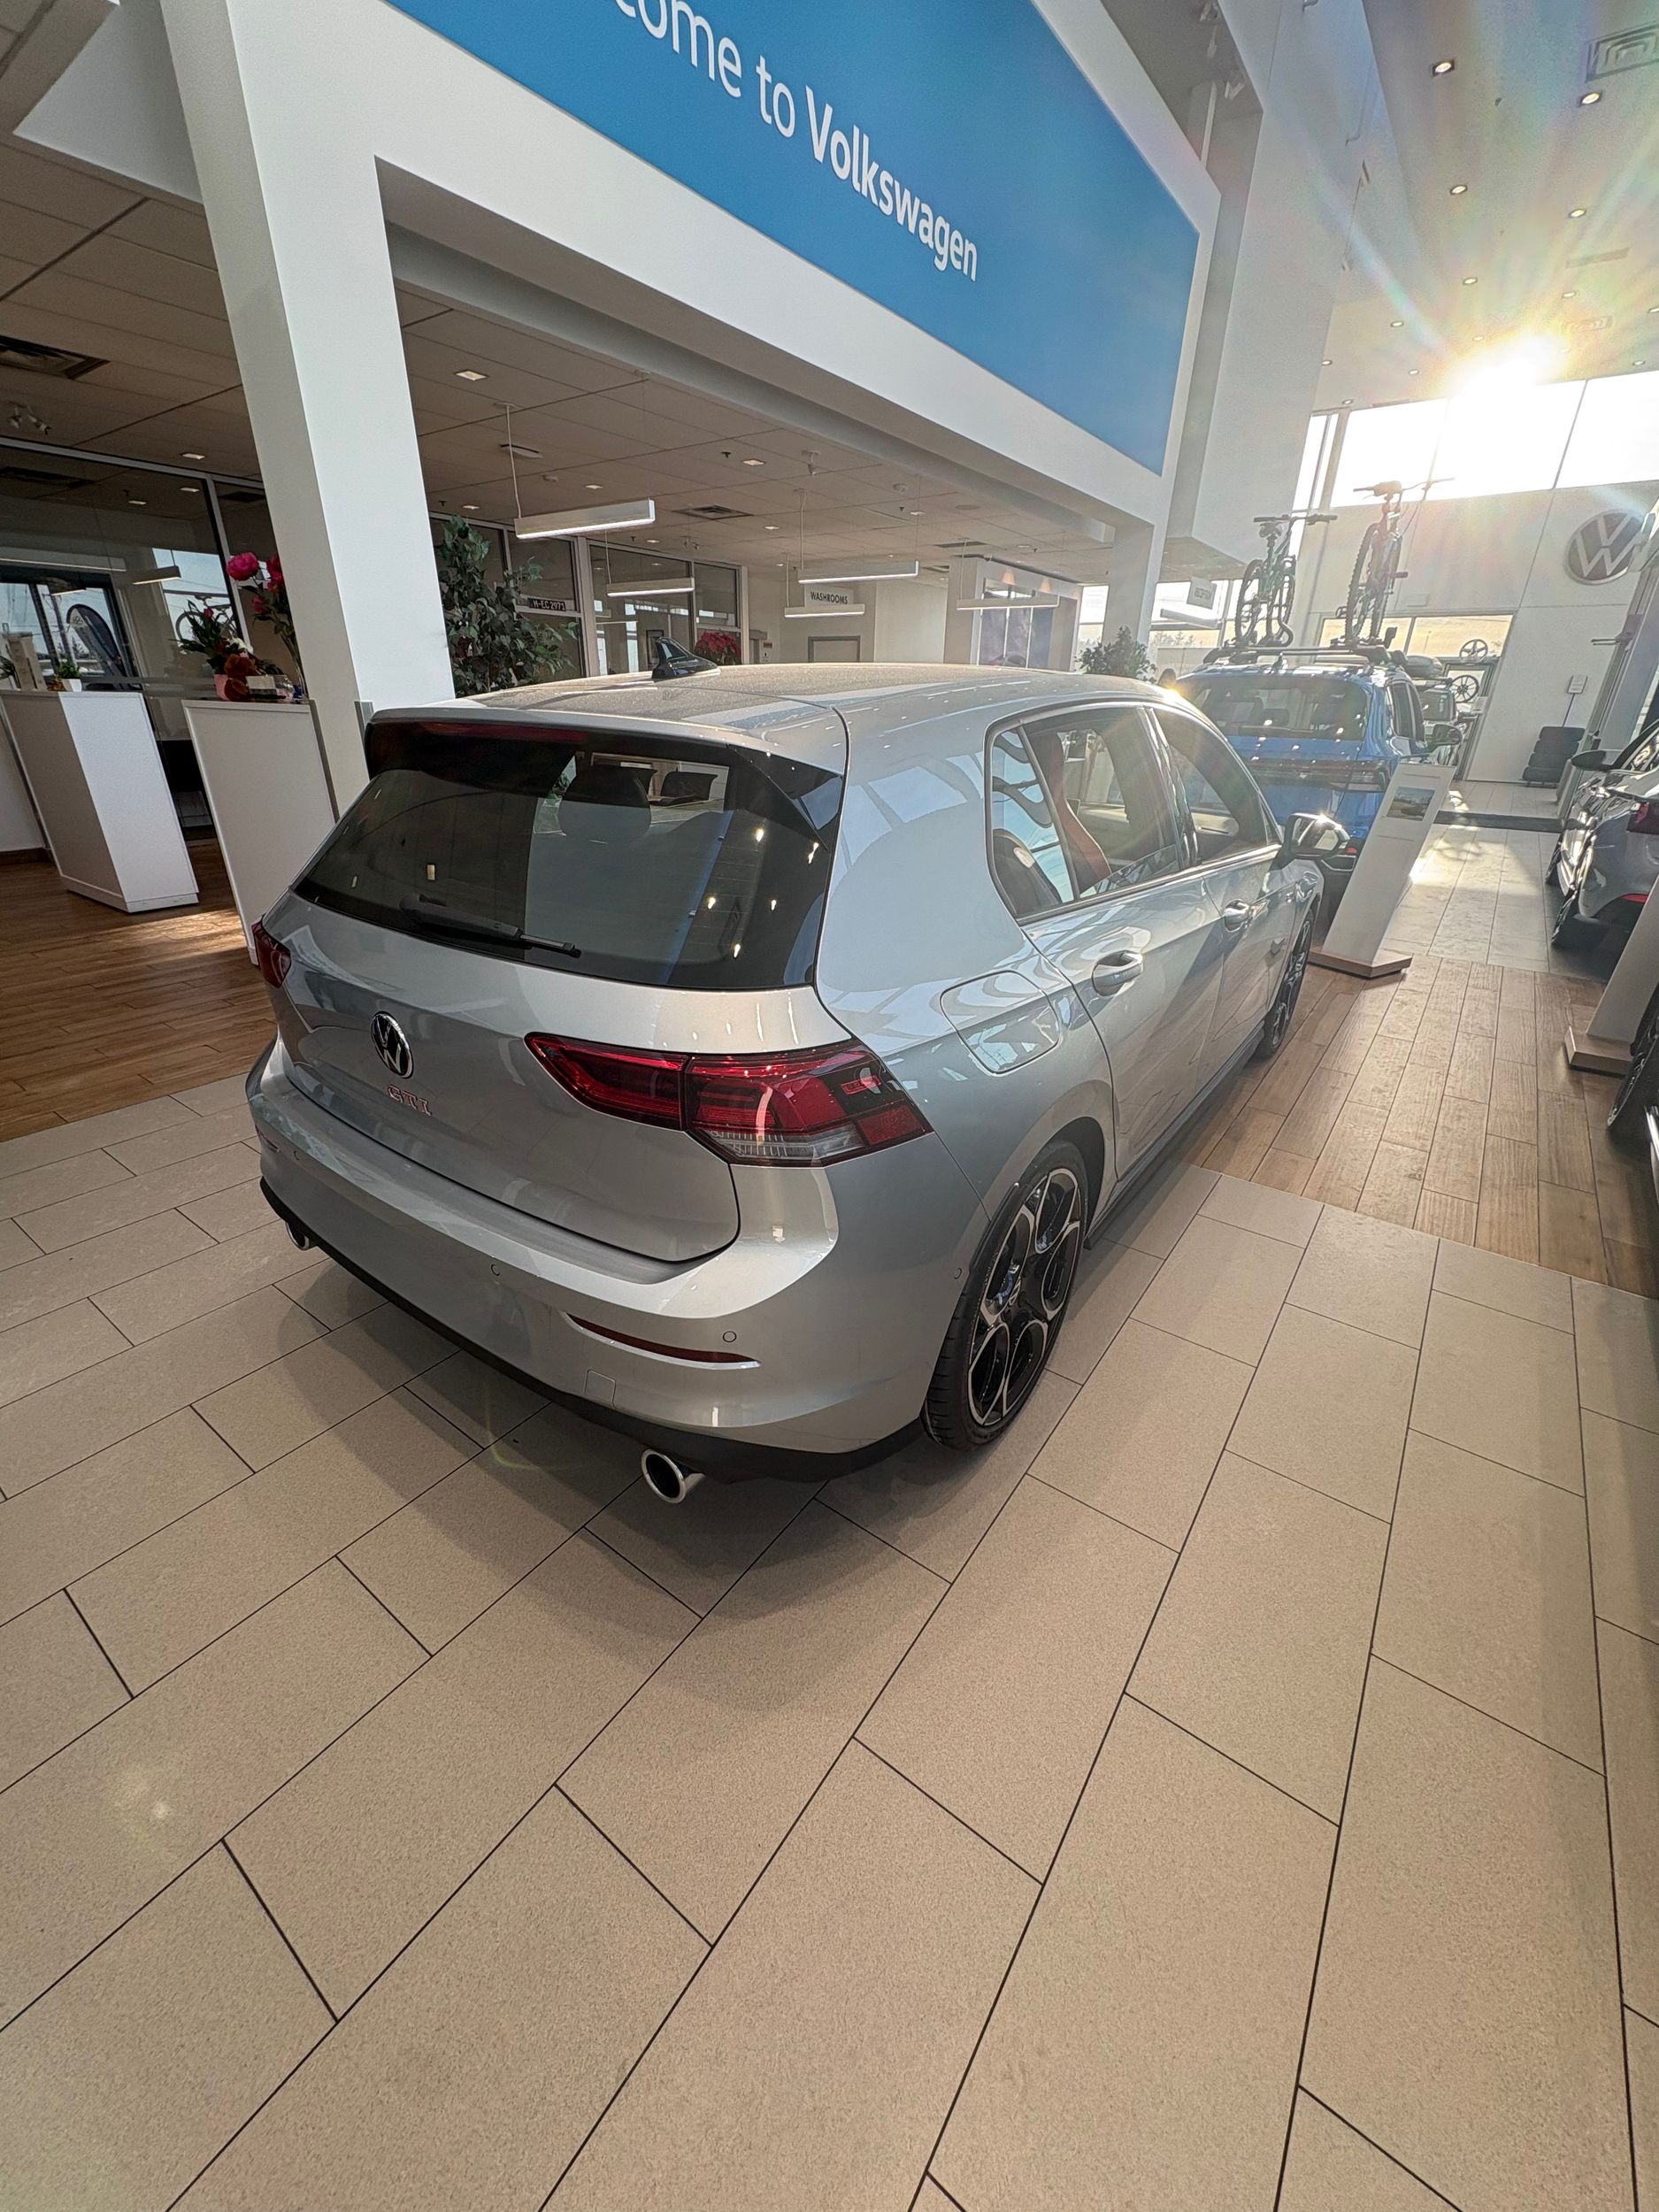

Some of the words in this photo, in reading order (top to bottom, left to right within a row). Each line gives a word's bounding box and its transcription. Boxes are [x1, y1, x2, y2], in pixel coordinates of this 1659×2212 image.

[616, 0, 742, 97] ome
[756, 55, 795, 138] to
[805, 85, 977, 281] Volkswagen
[810, 591, 849, 604] WASHROOMS
[387, 1084, 432, 1117] GTI
